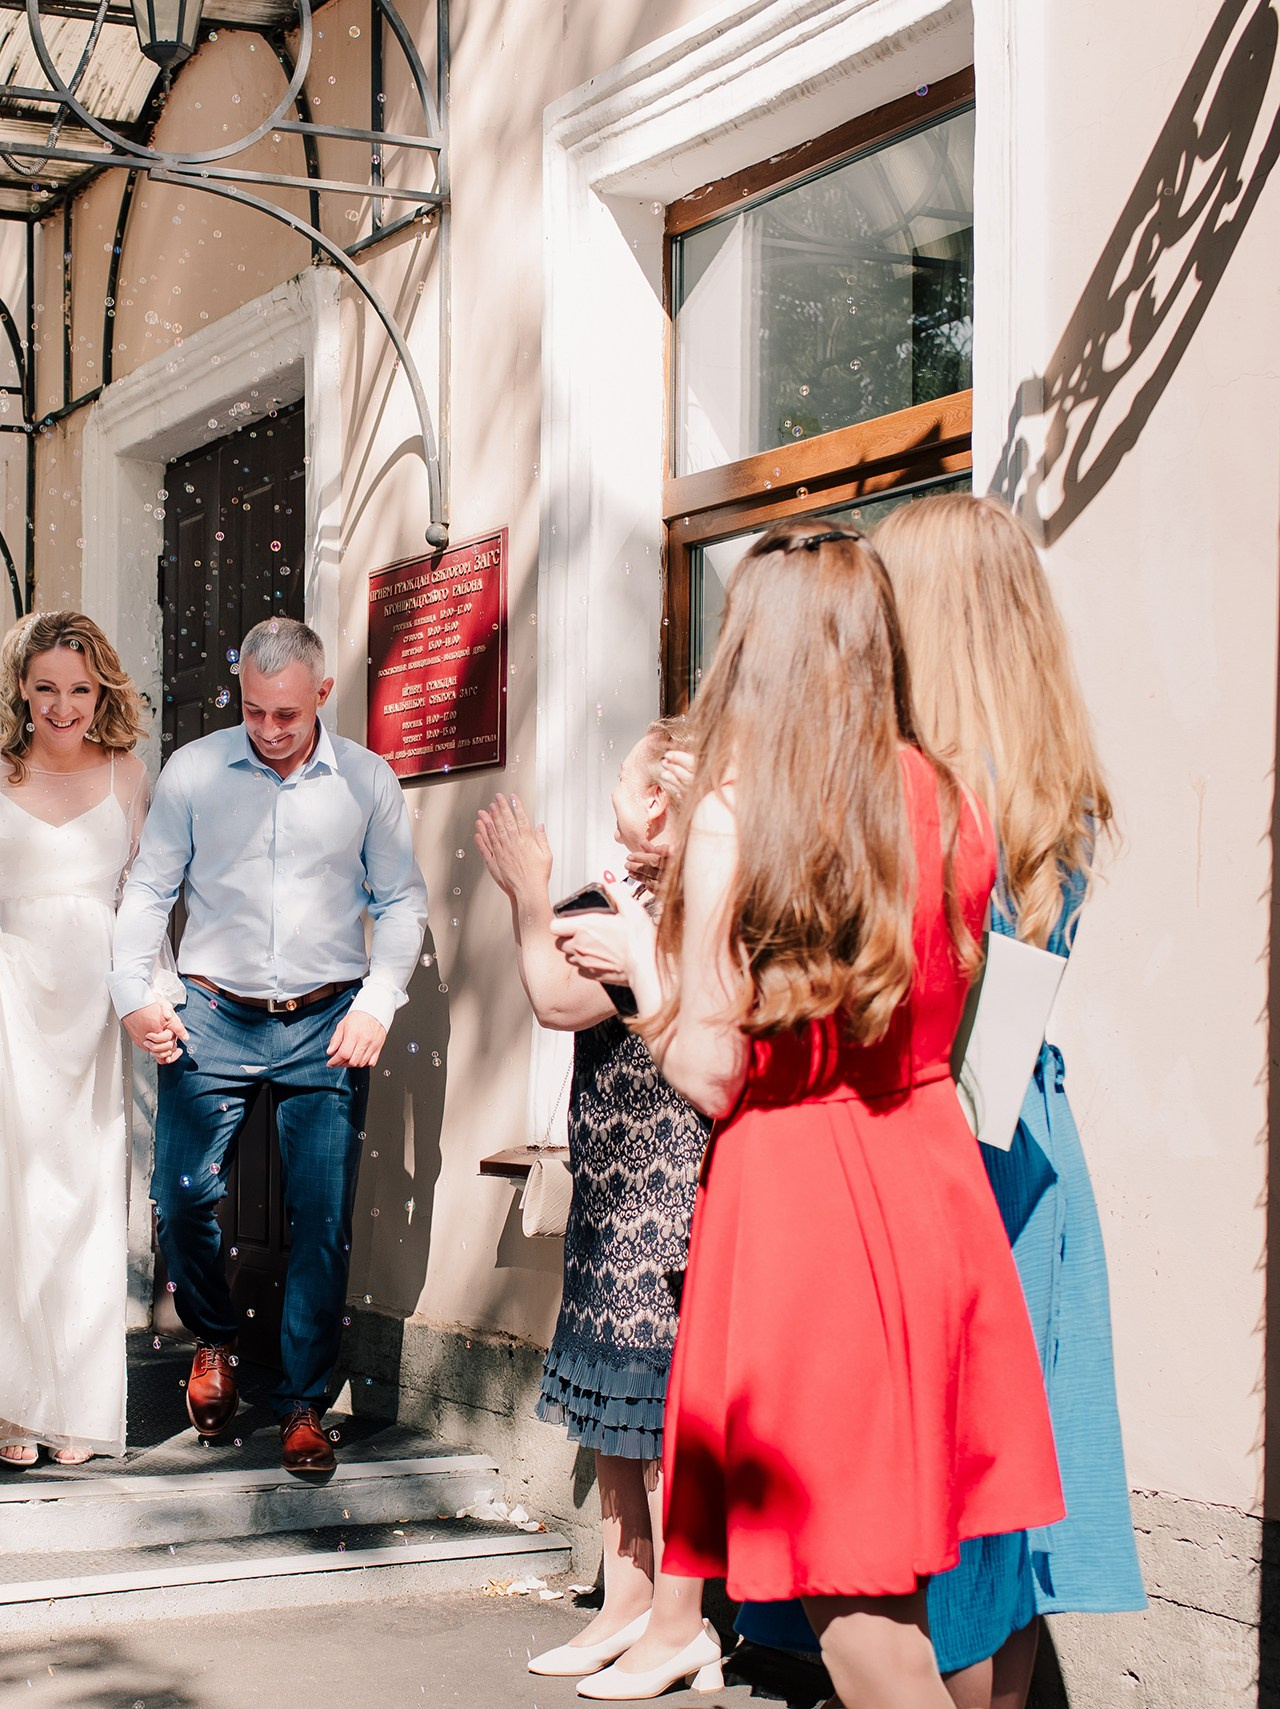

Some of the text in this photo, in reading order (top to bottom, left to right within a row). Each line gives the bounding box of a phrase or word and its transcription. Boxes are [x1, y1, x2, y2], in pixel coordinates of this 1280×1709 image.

[394, 575, 430, 595] ГРАЖДАН
[431, 562, 471, 583] СЕКТОРОМ
[474, 549, 500, 571] ЗАГС
[452, 578, 483, 598] РАЙОНА
[459, 686, 479, 698] ЗАГС
